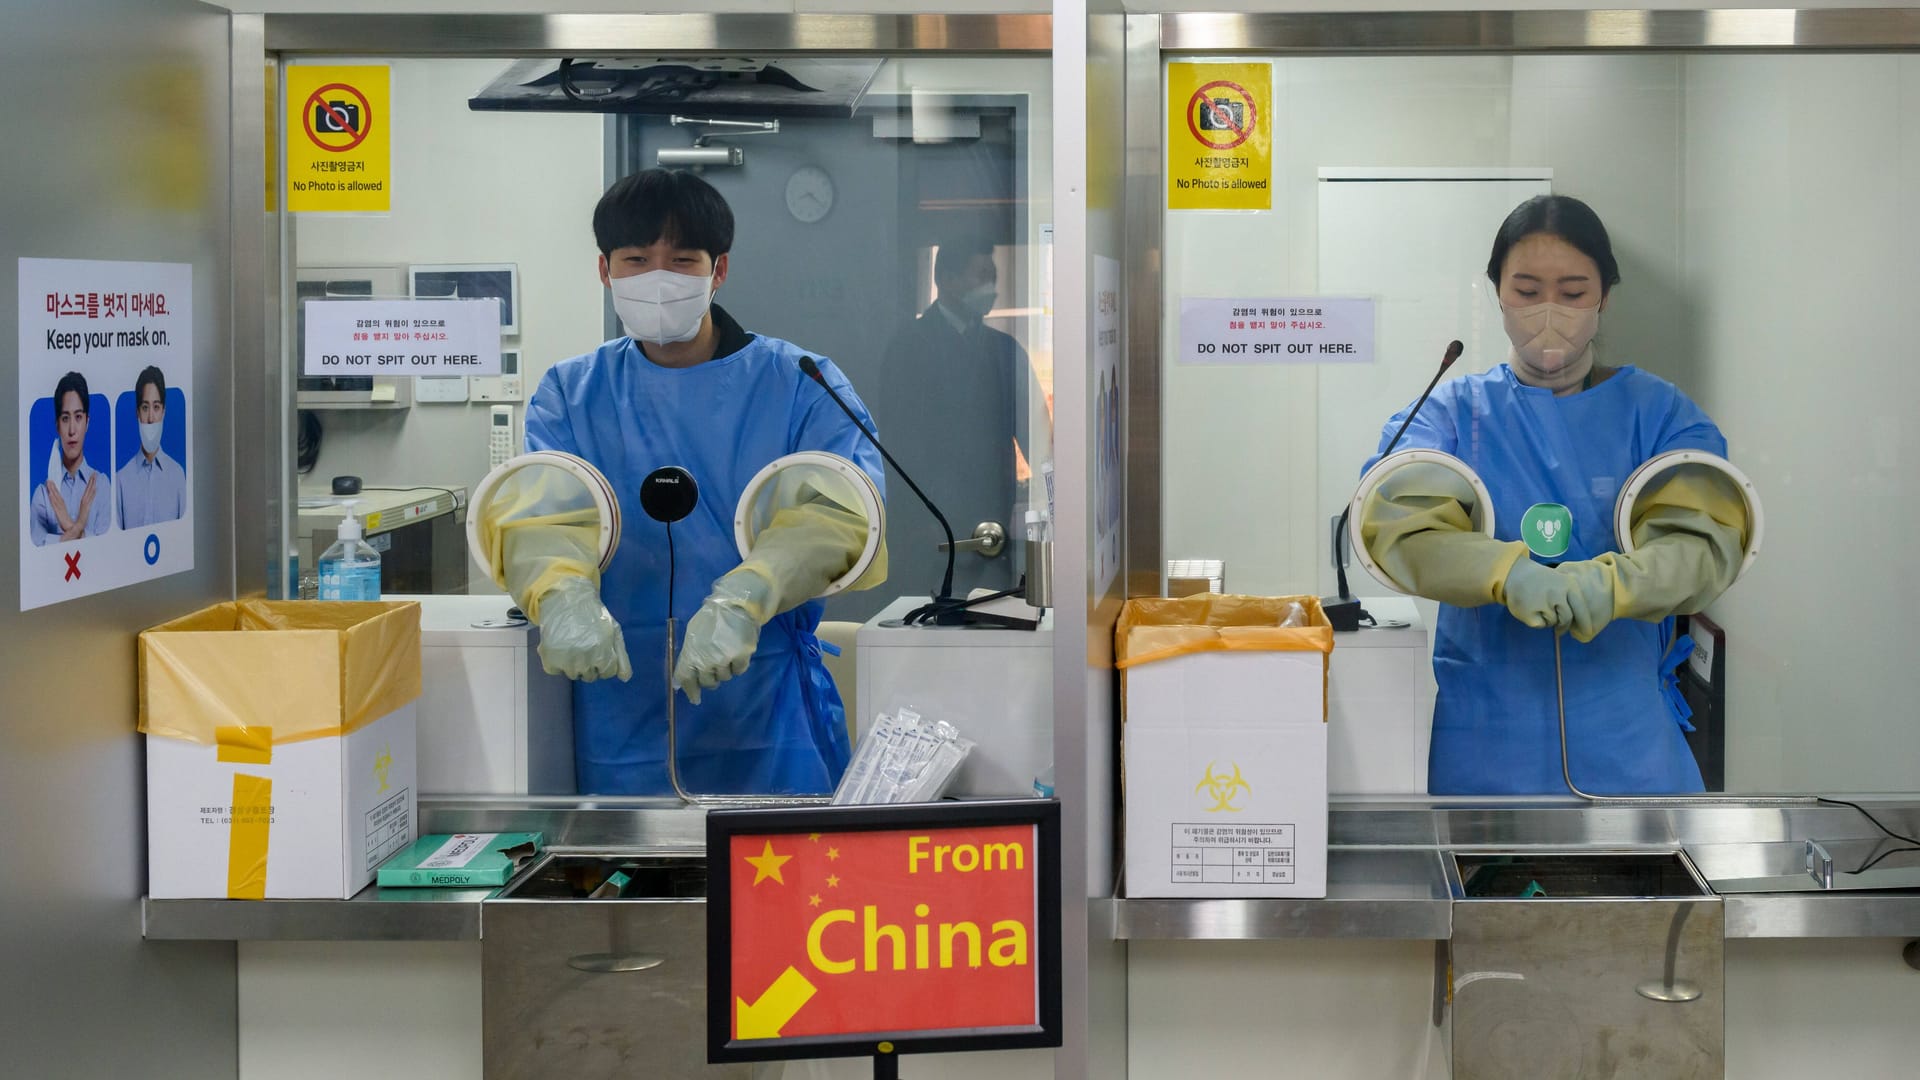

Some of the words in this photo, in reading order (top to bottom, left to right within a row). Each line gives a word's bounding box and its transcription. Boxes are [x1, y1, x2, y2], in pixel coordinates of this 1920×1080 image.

[311, 160, 365, 172] 사진촬영금지
[1194, 157, 1249, 168] 사진촬영금지
[293, 181, 306, 191] No
[308, 181, 335, 191] Photo
[337, 181, 345, 191] is
[347, 180, 382, 191] allowed
[1177, 178, 1190, 188] No
[1192, 178, 1220, 189] Photo
[1221, 178, 1229, 188] is
[1231, 178, 1267, 189] allowed
[46, 292, 100, 319] 마스크를
[103, 292, 128, 318] 벗지
[131, 292, 170, 317] 마세요.
[1232, 308, 1257, 316] 감염의
[1261, 308, 1285, 316] 위험이
[1290, 308, 1322, 316] 있으므로
[356, 319, 380, 328] 감염의
[384, 319, 409, 328] 위험이
[413, 319, 446, 328] 있으므로
[1229, 321, 1245, 330] 침을
[1270, 321, 1286, 330] 말아
[1290, 321, 1326, 330] 주십시오.
[47, 328, 82, 355] Keep
[83, 331, 114, 354] your
[116, 326, 149, 347] mask
[151, 329, 171, 347] on.
[353, 332, 369, 341] 침을
[393, 332, 410, 341] 말아
[413, 332, 449, 341] 주십시오.
[1197, 343, 1216, 354] DO
[1222, 343, 1248, 354] NOT
[1254, 343, 1281, 354] SPIT
[1287, 343, 1314, 354] OUT
[1319, 343, 1357, 354] HERE.
[322, 355, 340, 365] DO
[345, 355, 372, 365] NOT
[377, 355, 405, 365] SPIT
[411, 355, 437, 365] OUT
[443, 355, 482, 365] HERE.
[908, 836, 1025, 873] From
[431, 876, 471, 884] MEDPOLY
[806, 903, 1028, 974] China
